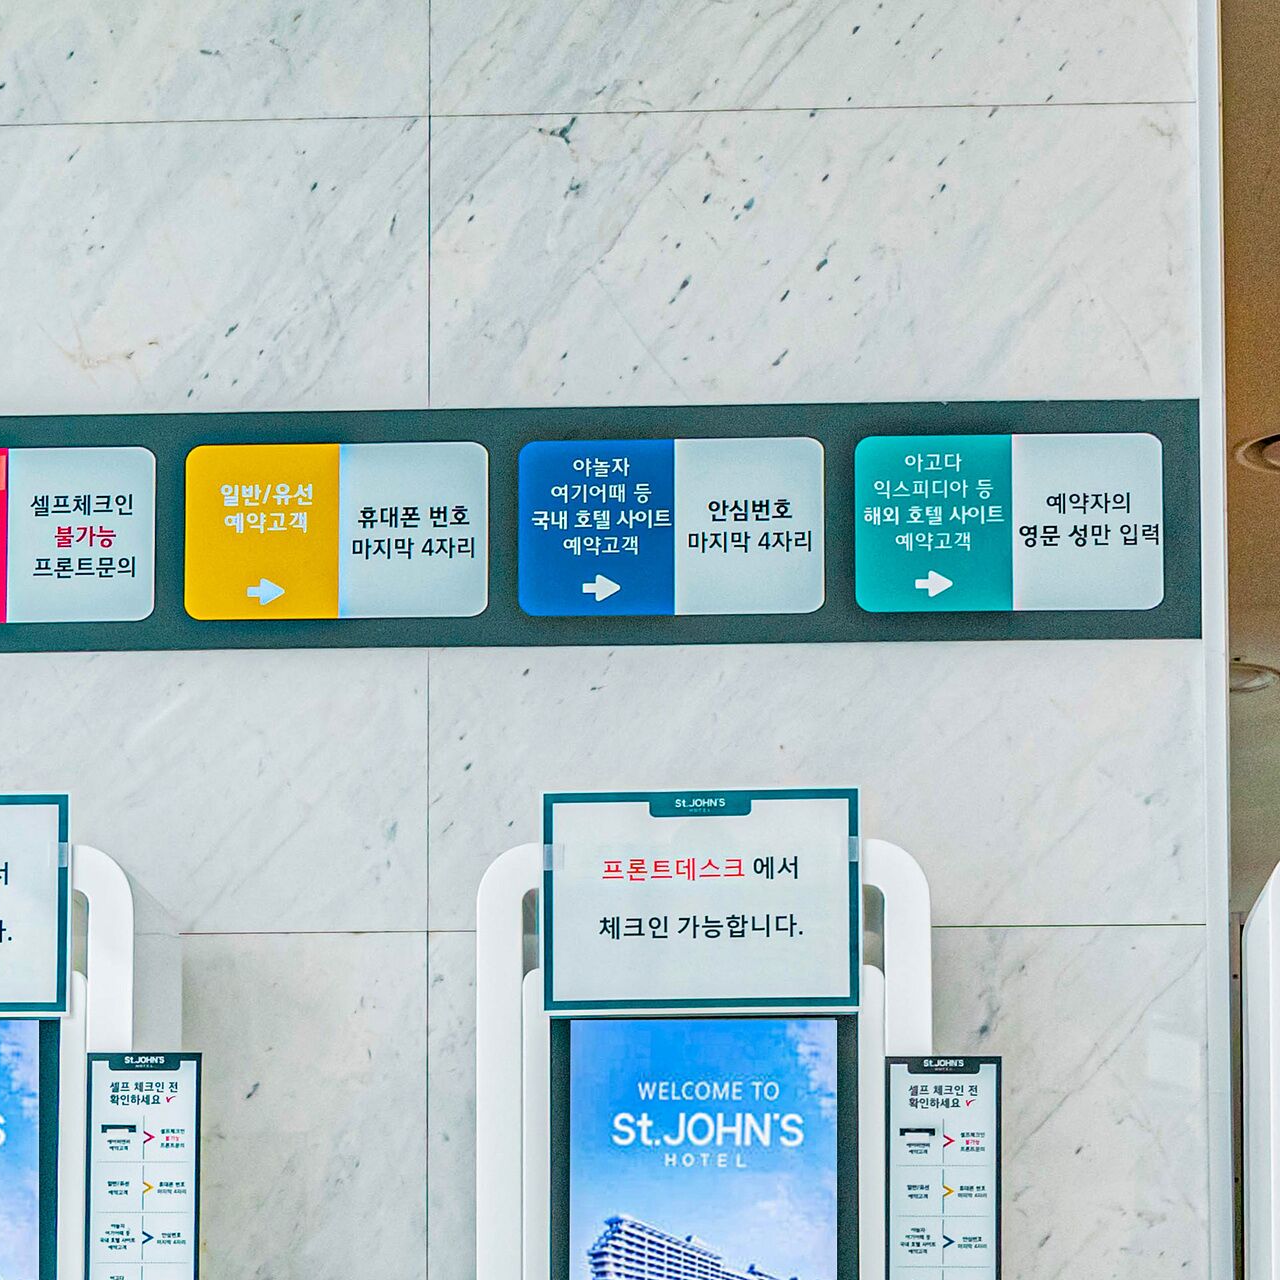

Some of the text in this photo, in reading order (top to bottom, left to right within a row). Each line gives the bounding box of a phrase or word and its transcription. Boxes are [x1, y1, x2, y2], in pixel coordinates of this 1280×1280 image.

[573, 457, 630, 478] 야놀자
[904, 454, 962, 472] 아고다
[220, 484, 313, 508] 일반/유선
[550, 483, 651, 504] 여기어때 등
[873, 479, 994, 499] 익스피디아 등
[30, 494, 134, 517] 셀프체크인
[707, 498, 793, 523] 안심번호
[1046, 492, 1131, 515] 예약자의
[224, 512, 308, 534] 예약고객
[358, 505, 470, 529] 휴대폰 번호
[532, 508, 672, 531] 국내 호텔 사이트
[864, 505, 1005, 526] 해외 호텔 사이트
[54, 526, 116, 550] 불가능
[563, 535, 640, 556] 예약고객
[687, 528, 813, 554] 마지막 4자리
[895, 532, 971, 552] 예약고객
[1019, 522, 1161, 547] 영문 성만 입력
[351, 536, 476, 560] 마지막 4자리
[32, 556, 137, 579] 프론트문의
[602, 856, 799, 881] 프론트데스크 에서
[599, 914, 804, 940] 체크인 가능합니다.
[110, 1081, 178, 1093] 셀프 체크인 전
[638, 1081, 780, 1101] WELCOME TO
[908, 1085, 978, 1096] 셀프 체크인 전
[109, 1094, 161, 1106] 확인하세요
[908, 1097, 961, 1109] 확인하세요
[612, 1112, 804, 1147] St.JOHN'S
[664, 1153, 747, 1168] HOTEL
